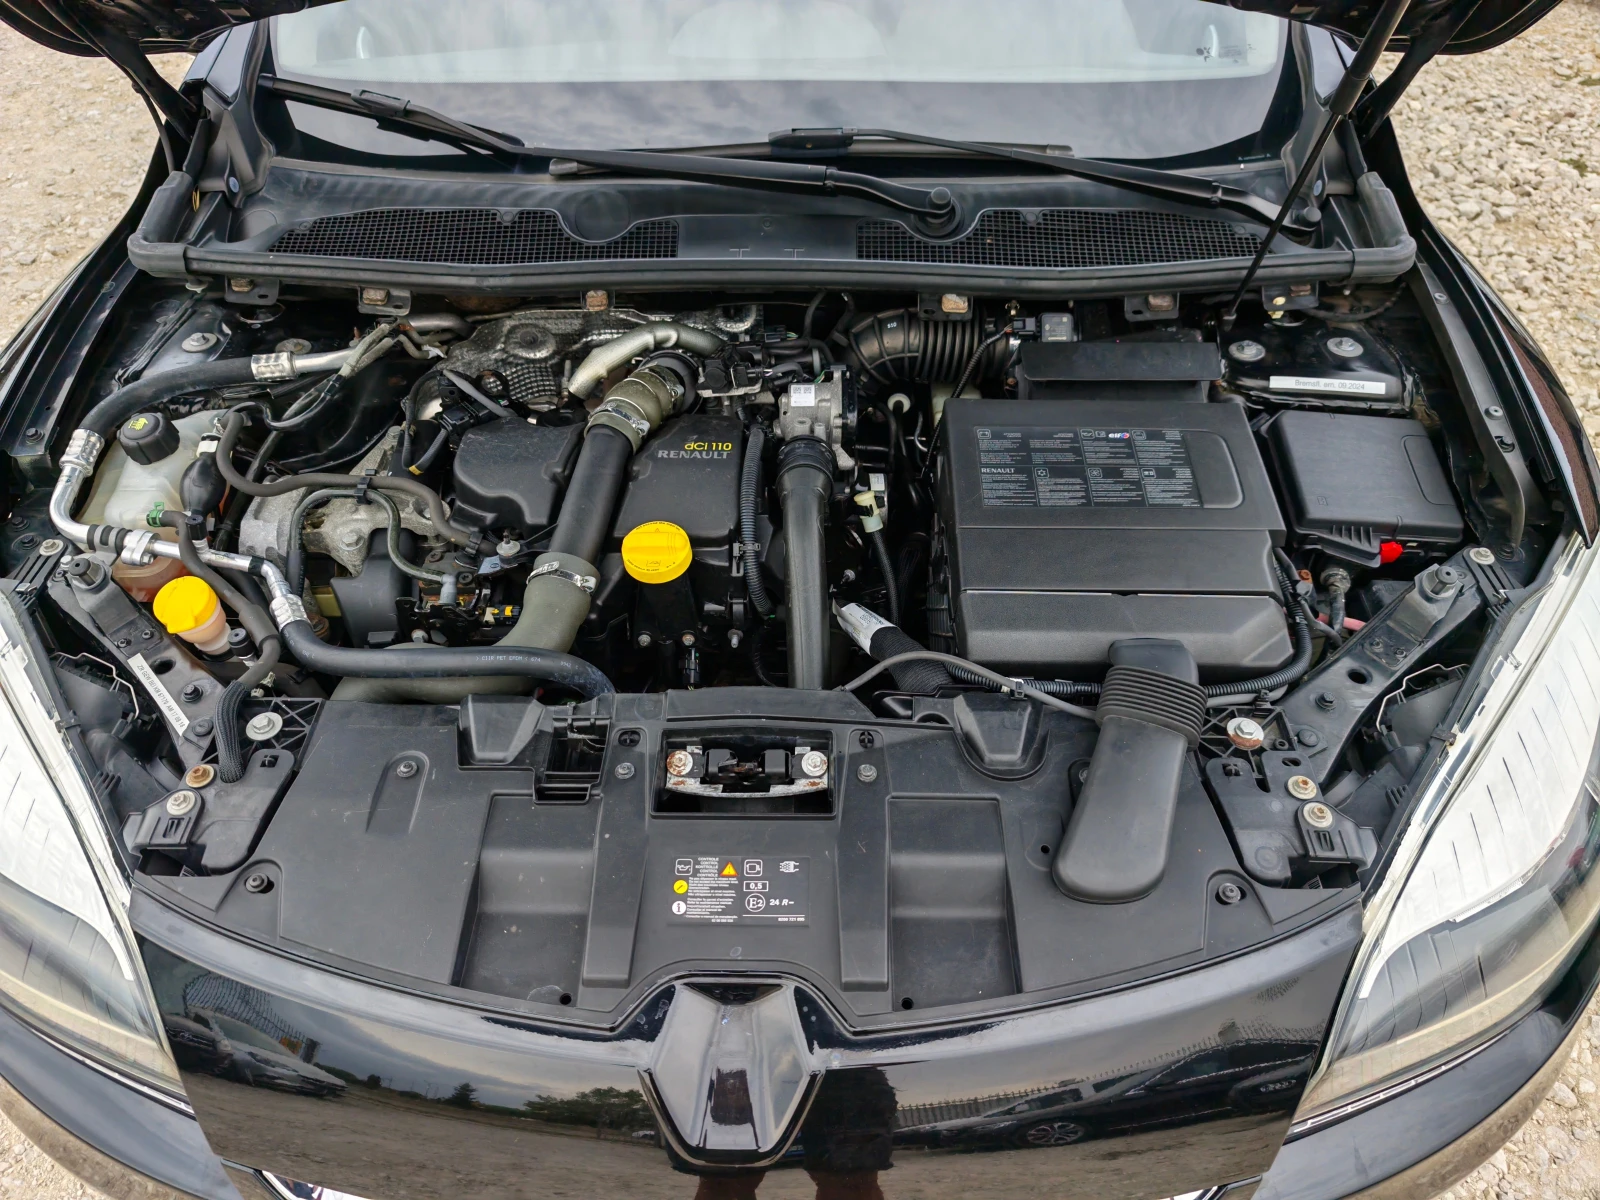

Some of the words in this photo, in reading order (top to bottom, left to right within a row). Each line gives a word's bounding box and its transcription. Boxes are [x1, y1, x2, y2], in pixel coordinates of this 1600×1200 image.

[1338, 382, 1365, 390] 09.2024
[684, 442, 708, 450] dCi
[712, 442, 732, 450] 110
[658, 450, 731, 459] RENAULT
